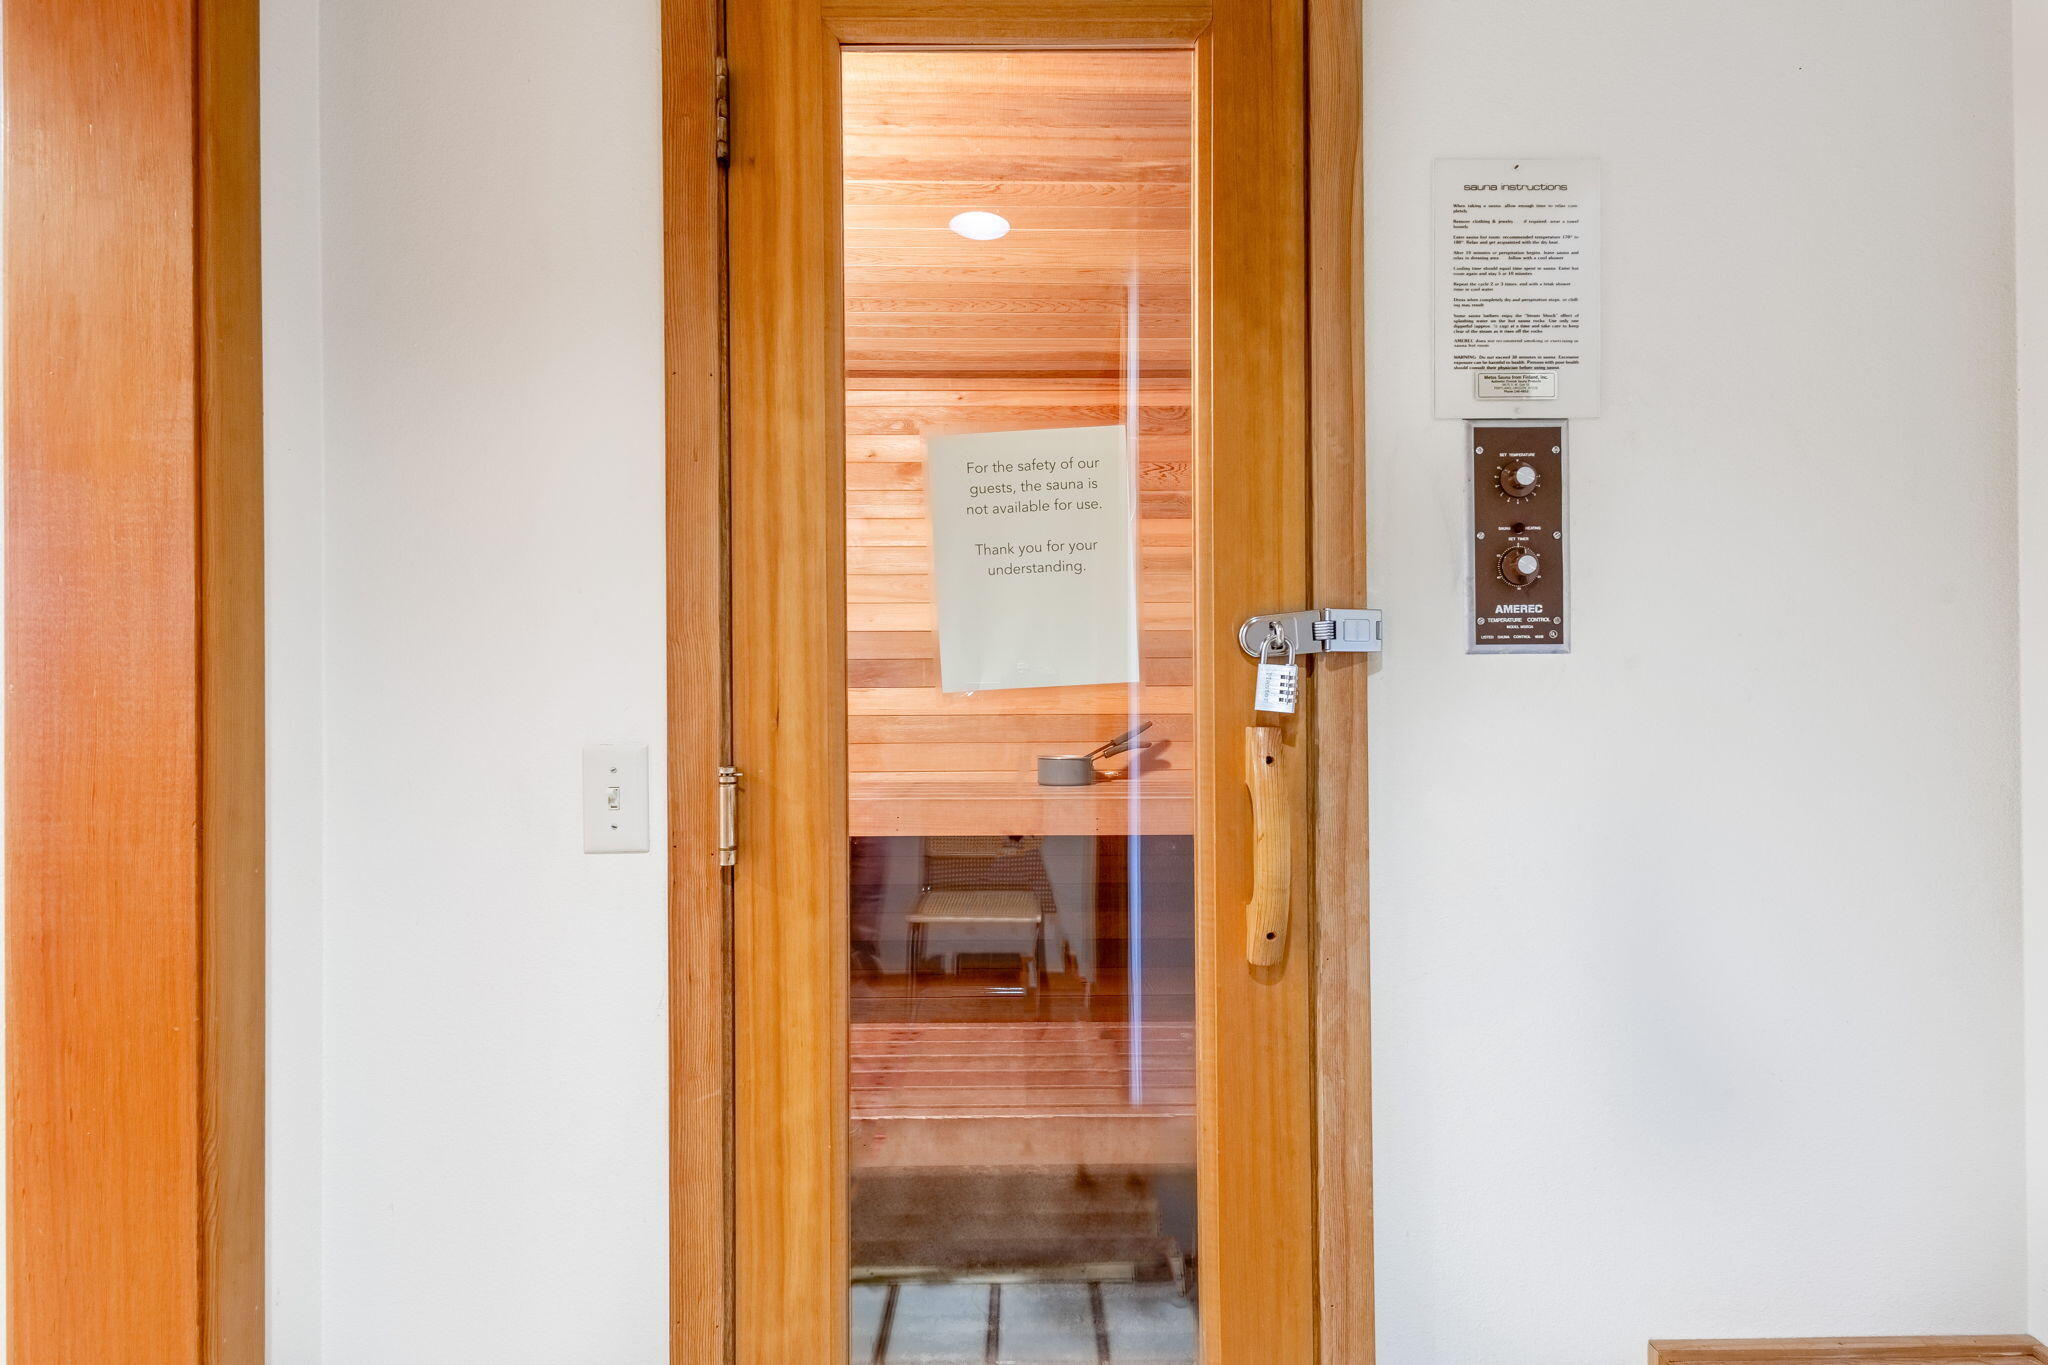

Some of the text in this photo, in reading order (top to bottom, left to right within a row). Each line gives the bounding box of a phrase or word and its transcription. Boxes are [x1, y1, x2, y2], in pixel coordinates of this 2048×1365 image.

[967, 457, 1099, 473] For the safety of our
[970, 478, 1097, 497] guests, the sauna is
[967, 498, 1102, 514] not available for use.
[975, 540, 1098, 557] Thank you for your
[988, 560, 1086, 575] understanding.
[1495, 604, 1543, 613] AMEREC
